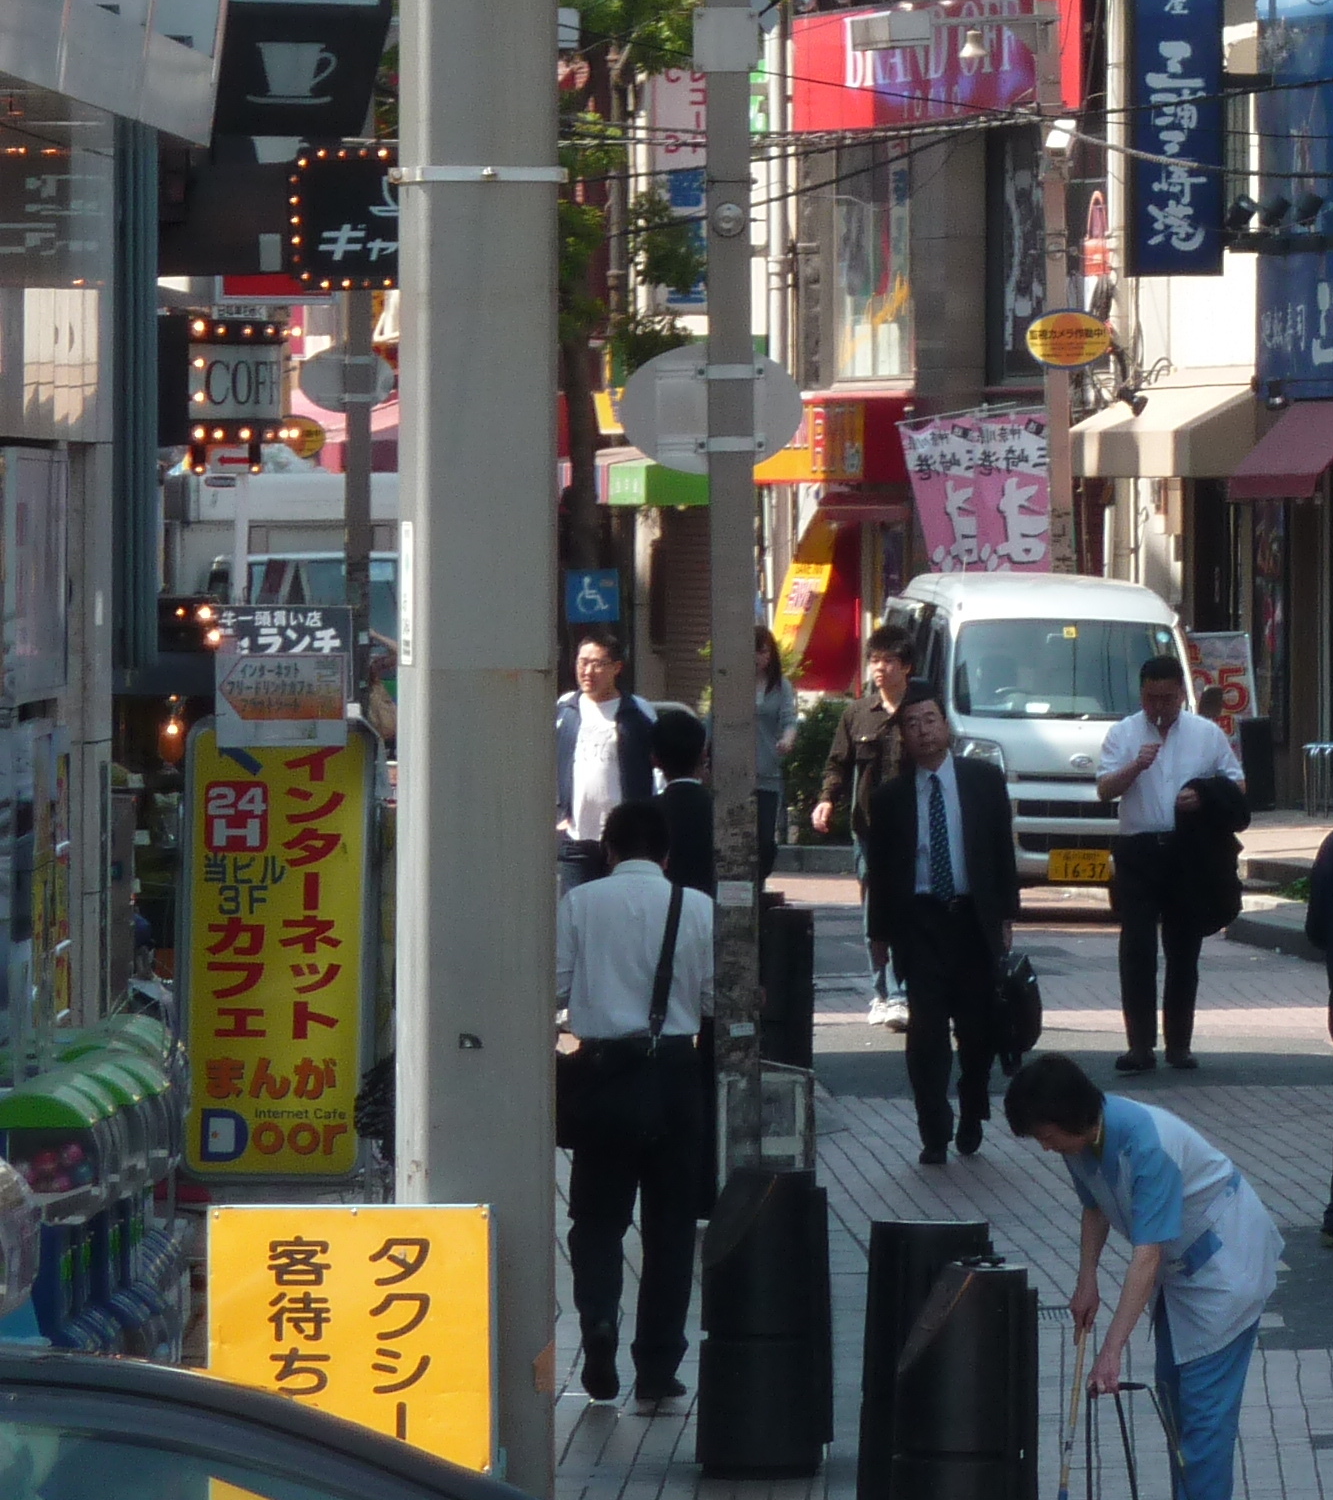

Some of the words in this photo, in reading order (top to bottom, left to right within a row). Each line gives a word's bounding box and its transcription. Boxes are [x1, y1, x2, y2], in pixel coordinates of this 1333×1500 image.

[206, 785, 268, 817] 24
[203, 853, 287, 886] 当ビル
[217, 884, 269, 916] 3F
[278, 745, 347, 1041] インターネット
[205, 916, 268, 1039] カフェ
[204, 1055, 339, 1101] まんが
[254, 1106, 310, 1121] Internet
[313, 1106, 348, 1121] Cafe
[267, 1236, 332, 1396] 客待ち
[367, 1236, 432, 1442] タクシー
